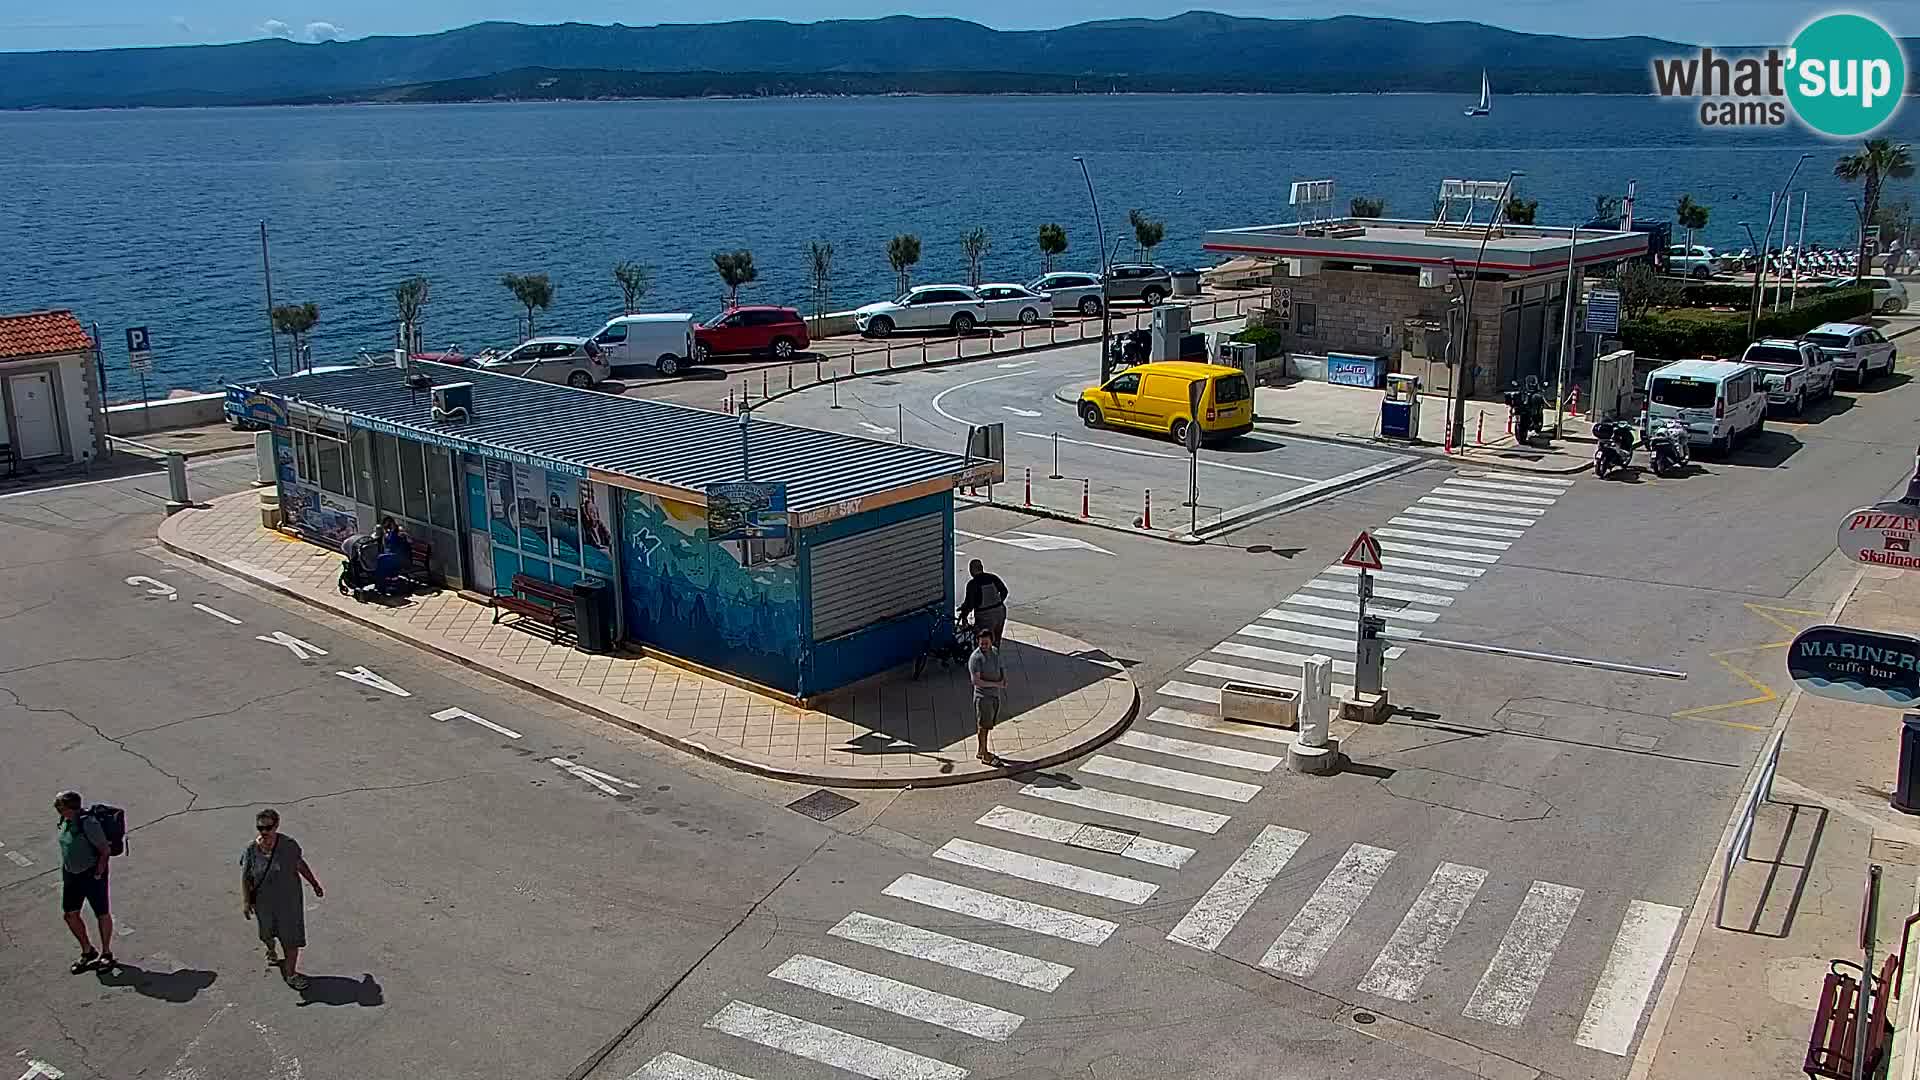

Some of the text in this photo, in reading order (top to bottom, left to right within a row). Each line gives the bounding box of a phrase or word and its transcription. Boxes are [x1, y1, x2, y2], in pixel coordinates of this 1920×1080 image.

[131, 330, 144, 349] P
[479, 445, 494, 456] BUS
[494, 448, 527, 465] STATION
[529, 456, 555, 470] TICKET
[556, 462, 583, 477] OFFICE
[1848, 513, 1920, 533] PIZZE
[1828, 661, 1897, 679] caffe bar
